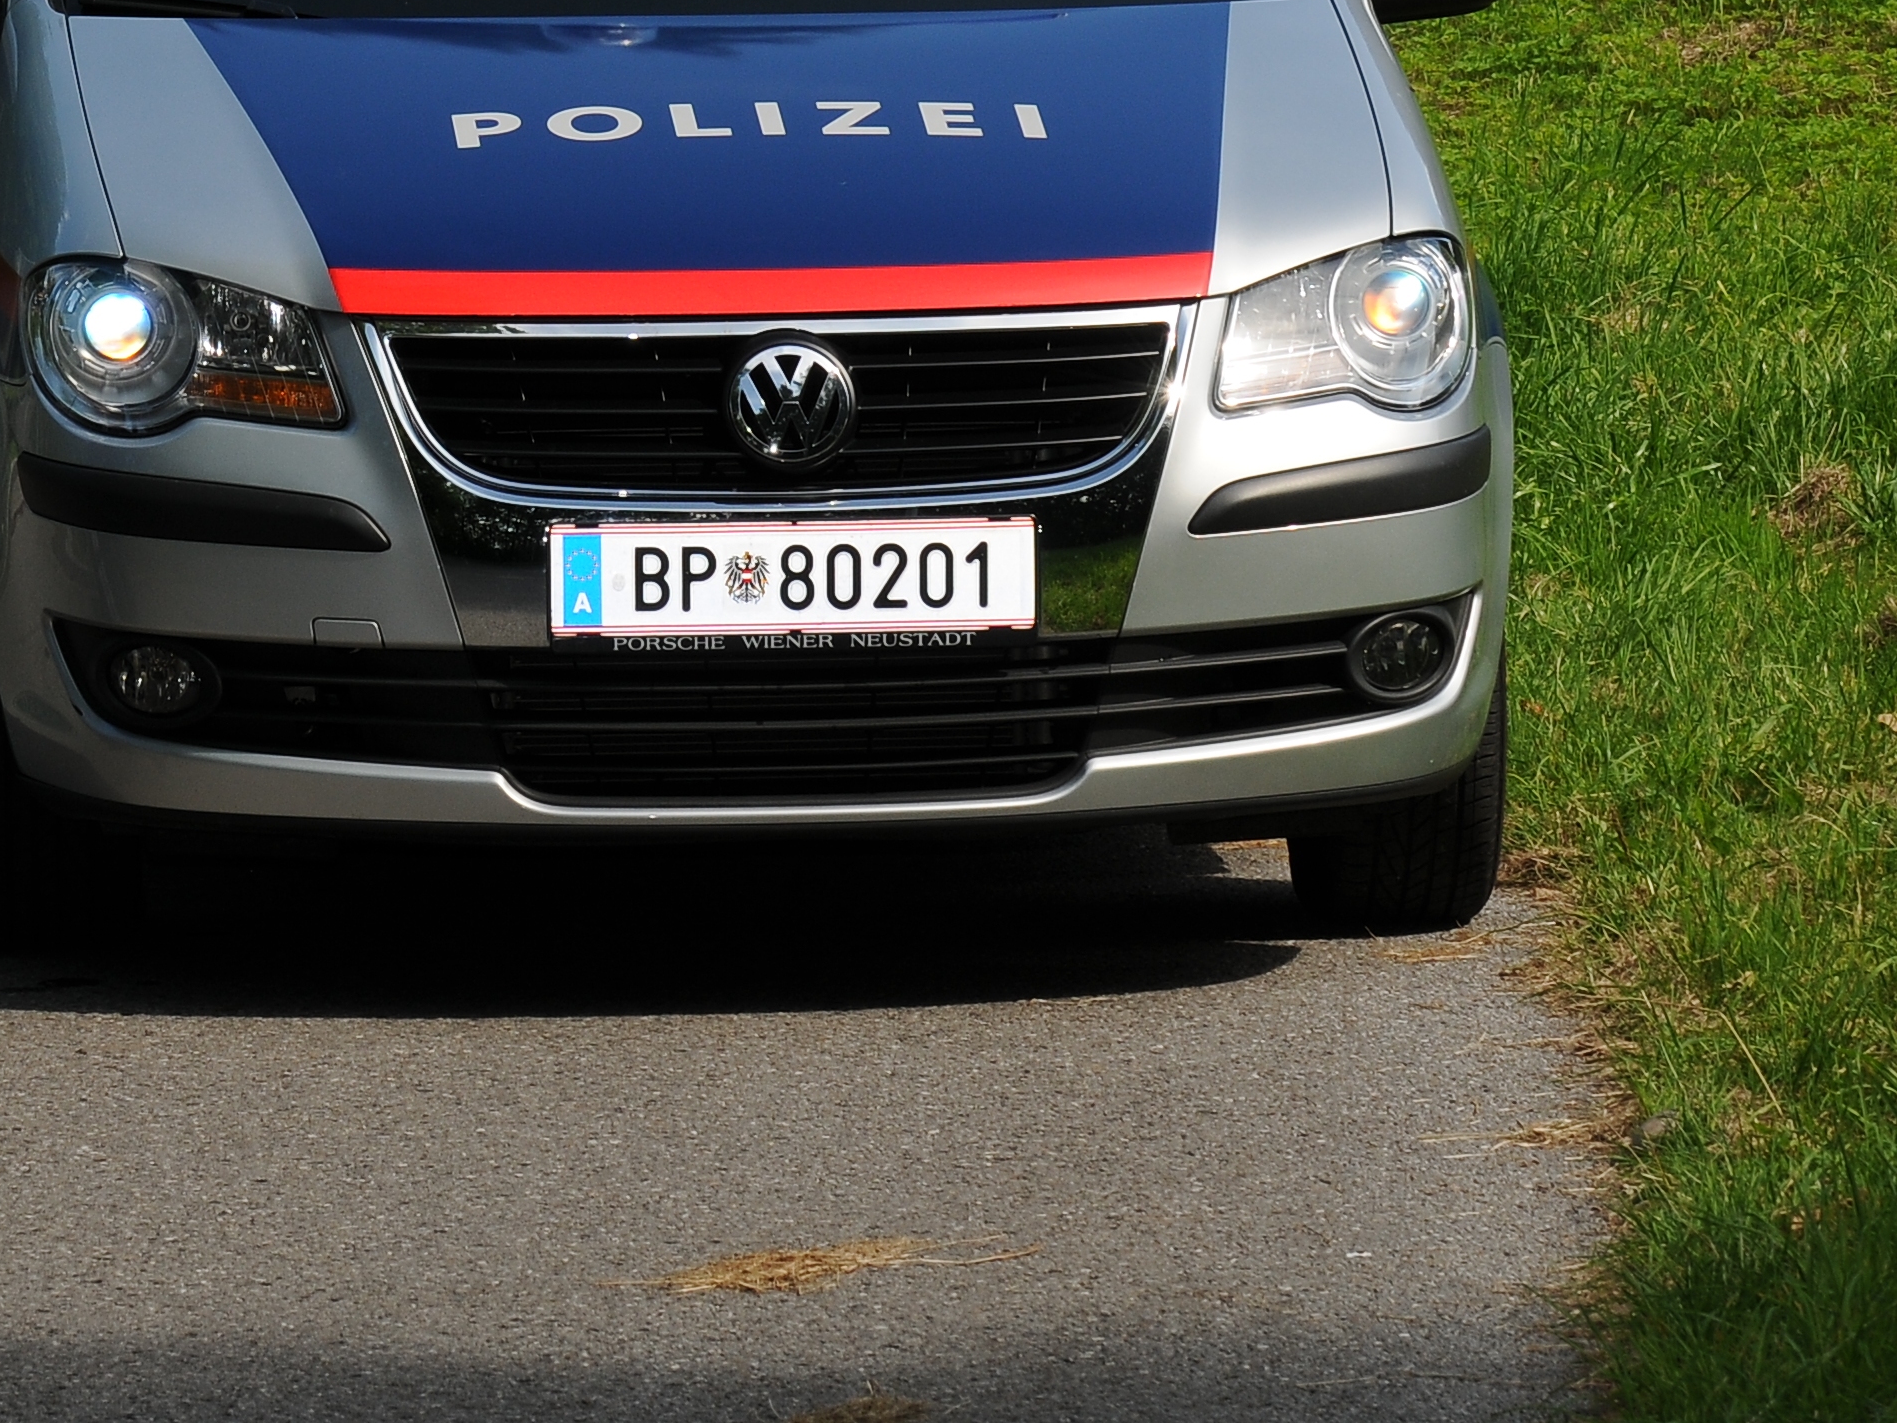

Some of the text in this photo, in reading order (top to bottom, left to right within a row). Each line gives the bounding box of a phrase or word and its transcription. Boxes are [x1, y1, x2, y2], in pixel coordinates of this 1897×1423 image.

[450, 101, 1048, 149] POLIZEI
[730, 342, 854, 462] VW
[634, 541, 989, 612] BP 80201
[573, 592, 592, 613] A
[613, 632, 977, 651] PORSCHE WIENER NEUSTADT
